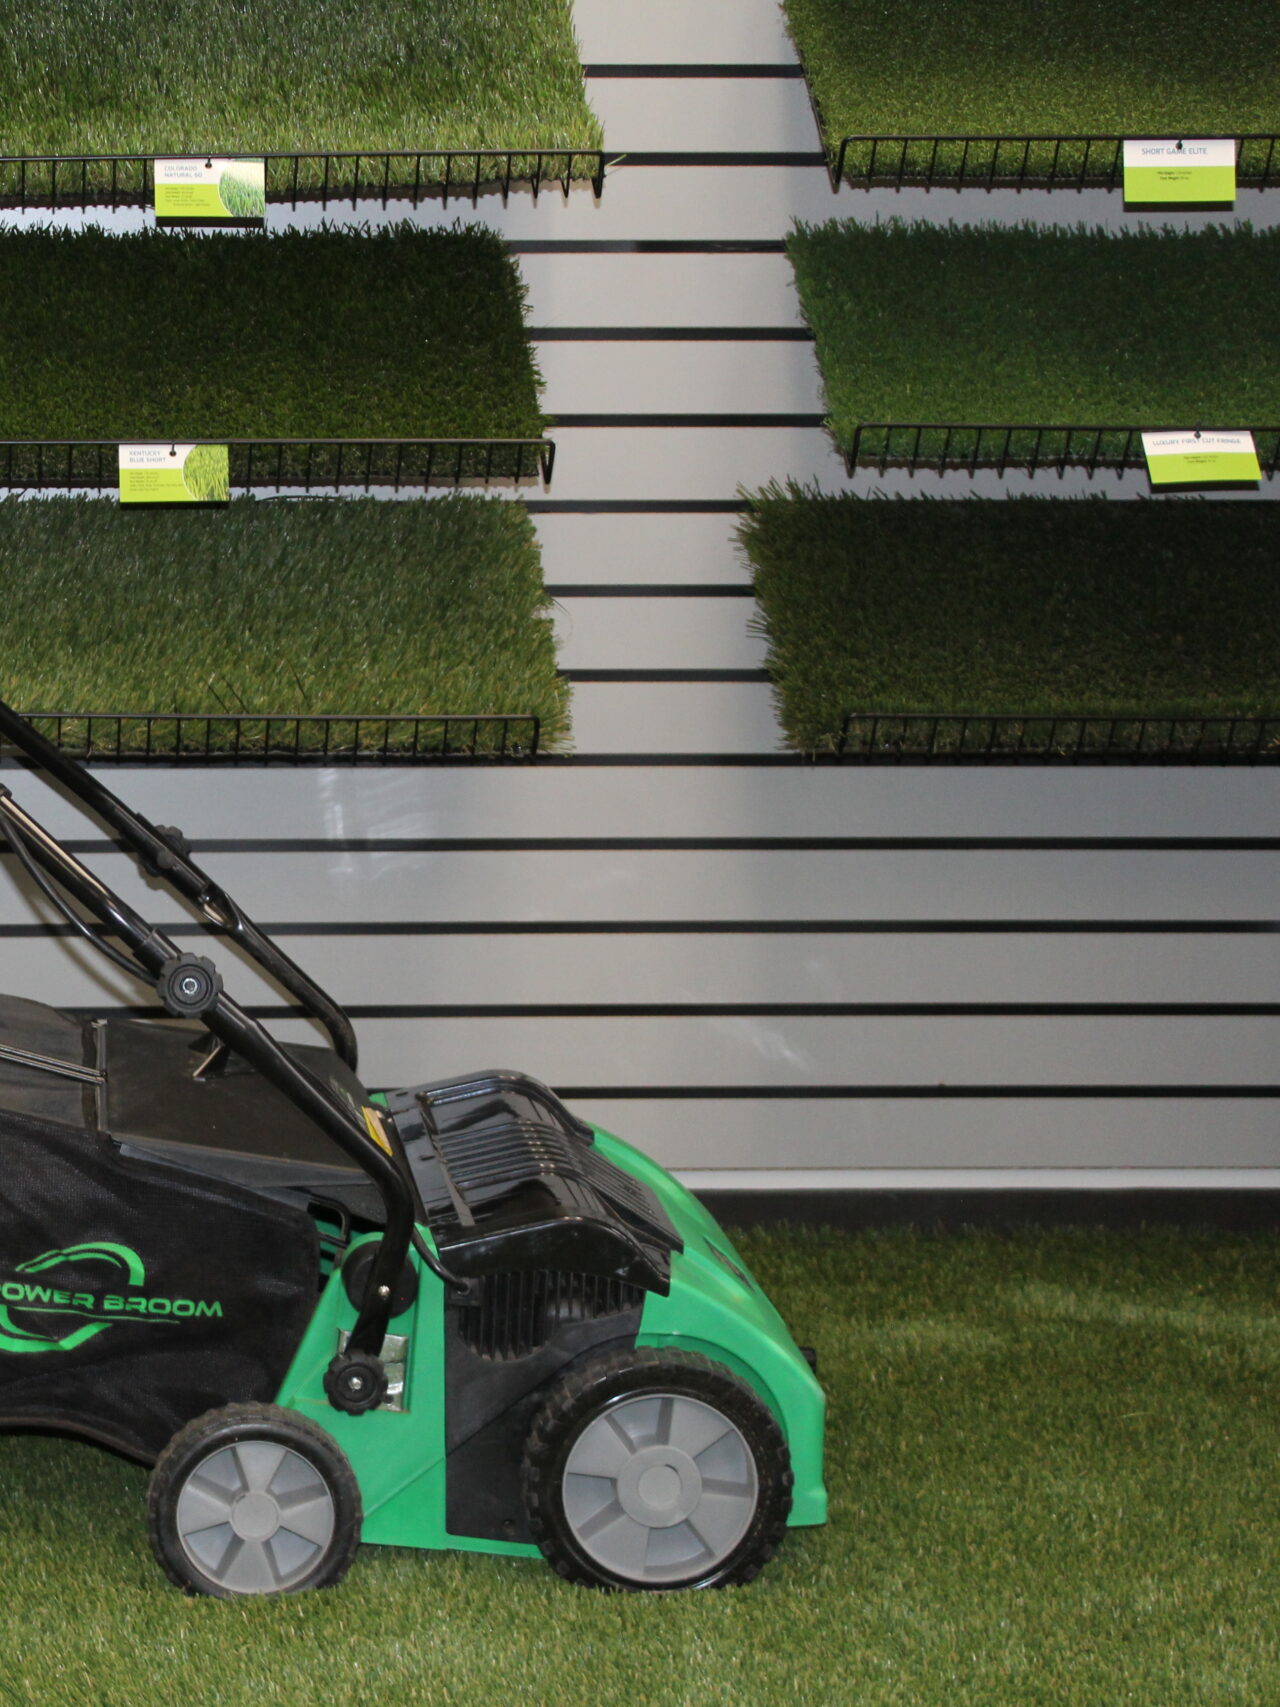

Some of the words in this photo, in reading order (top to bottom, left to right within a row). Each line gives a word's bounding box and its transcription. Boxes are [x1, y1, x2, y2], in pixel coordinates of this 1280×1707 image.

[1141, 147, 1165, 155] SHORT
[1166, 147, 1187, 155] GAME
[1188, 147, 1208, 155] ELITE
[103, 1294, 224, 1318] BROOM
